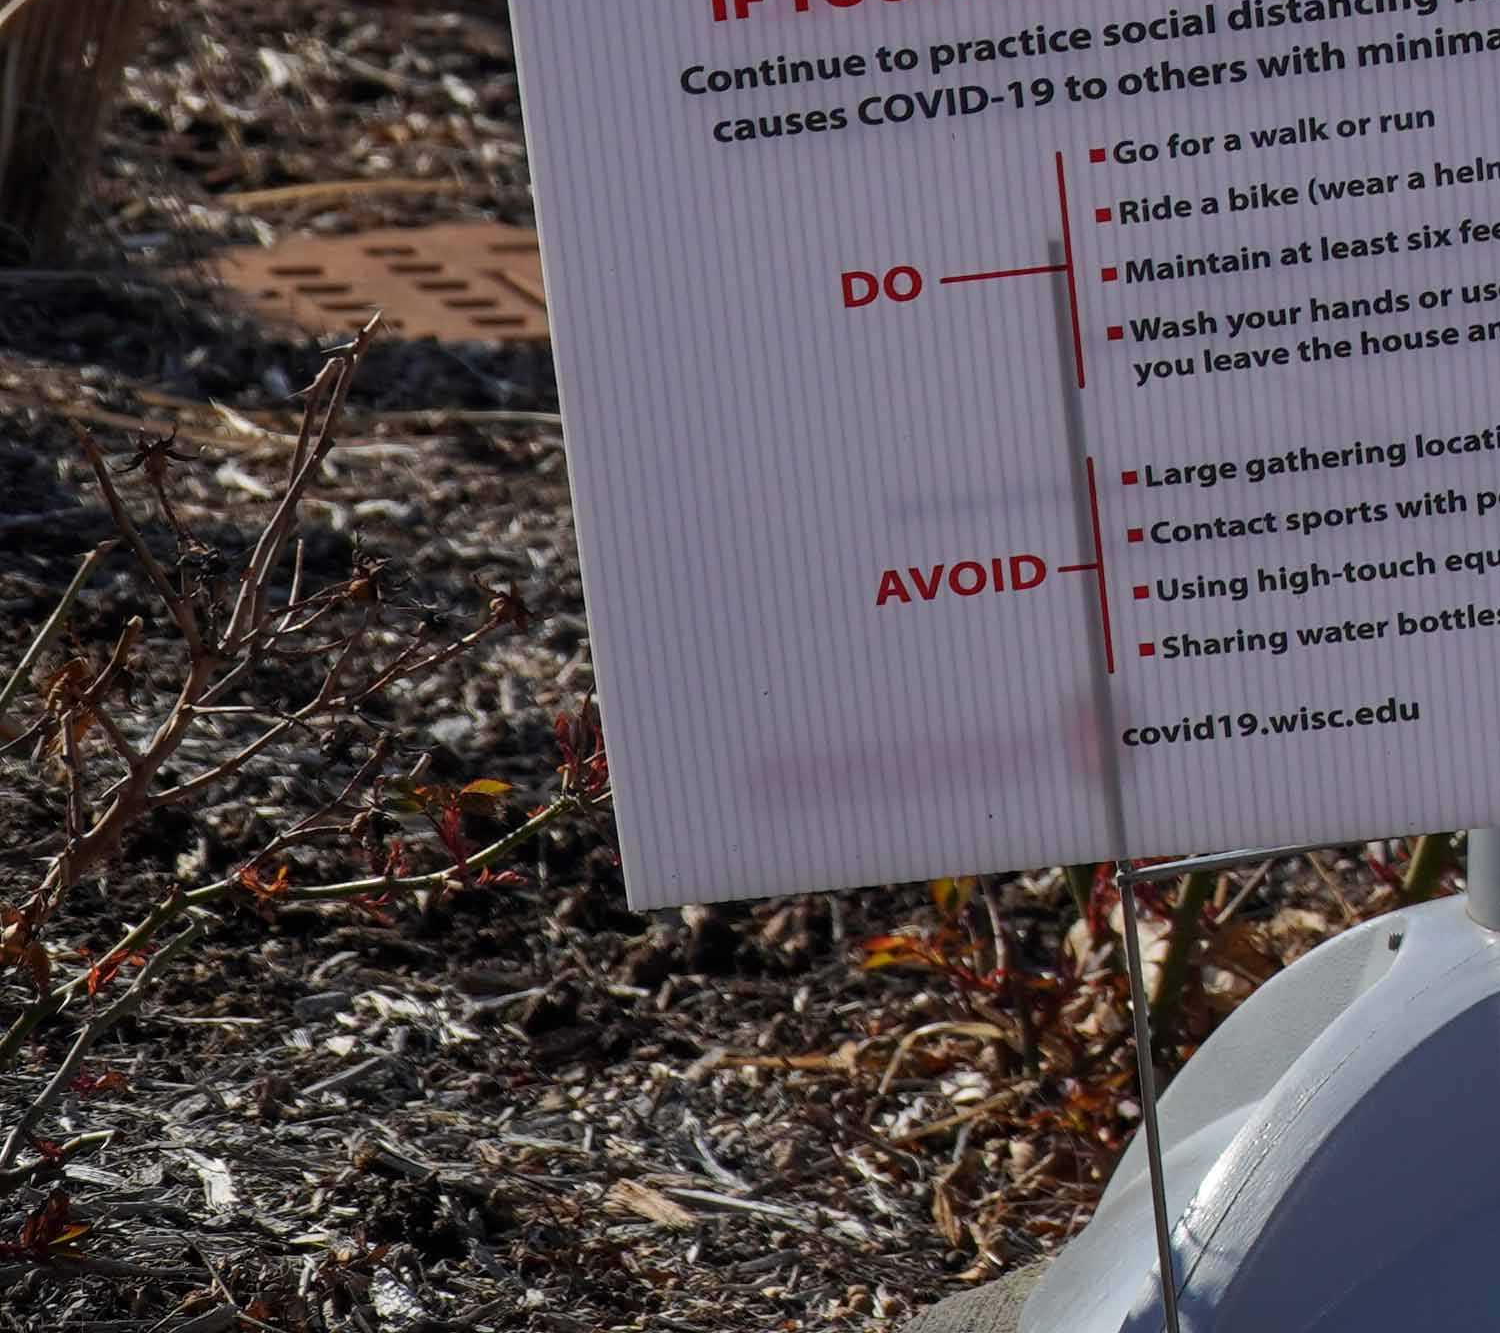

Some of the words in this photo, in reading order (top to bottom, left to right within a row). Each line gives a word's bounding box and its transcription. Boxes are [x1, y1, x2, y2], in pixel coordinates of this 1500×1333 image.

[679, 54, 867, 96] Continue
[874, 45, 919, 73] to
[929, 24, 1093, 75] practice
[1102, 3, 1217, 47] social
[712, 106, 849, 144] causes
[857, 77, 1055, 126] COVID-19
[1064, 75, 1108, 102] to
[1117, 60, 1248, 96] others
[1255, 40, 1346, 79] with
[1112, 139, 1160, 165] Go
[1166, 132, 1215, 159] for
[1223, 133, 1242, 153] a
[1249, 116, 1330, 149] walk
[1336, 116, 1372, 138] or
[1379, 109, 1436, 134] run
[1119, 194, 1193, 225] Ride
[1200, 196, 1220, 216] a
[1227, 182, 1300, 213] bike
[1308, 174, 1400, 206] (wear
[1407, 171, 1426, 191] a
[1125, 246, 1272, 285] Maintain
[1279, 240, 1313, 267] at
[1320, 230, 1400, 262] least
[1407, 224, 1453, 252] six
[840, 265, 923, 309] DO
[1129, 310, 1218, 343] Wash
[1225, 306, 1302, 339] your
[1309, 288, 1411, 323] hands
[1418, 288, 1454, 310] or
[1133, 357, 1195, 388] you
[1203, 346, 1290, 374] leave
[1296, 336, 1353, 363] the
[1360, 326, 1460, 356] house
[1144, 461, 1238, 489] Large
[1245, 440, 1407, 484] gathering
[1149, 511, 1278, 545] Contact
[1285, 501, 1389, 536] sports
[1394, 488, 1468, 519] with
[876, 553, 1048, 607] AVOID
[1156, 574, 1249, 603] Using
[1257, 550, 1437, 596] high-touch
[1161, 628, 1289, 660] Sharing
[1295, 620, 1390, 647] water
[1121, 696, 1420, 748] covid19.wisc.edu
